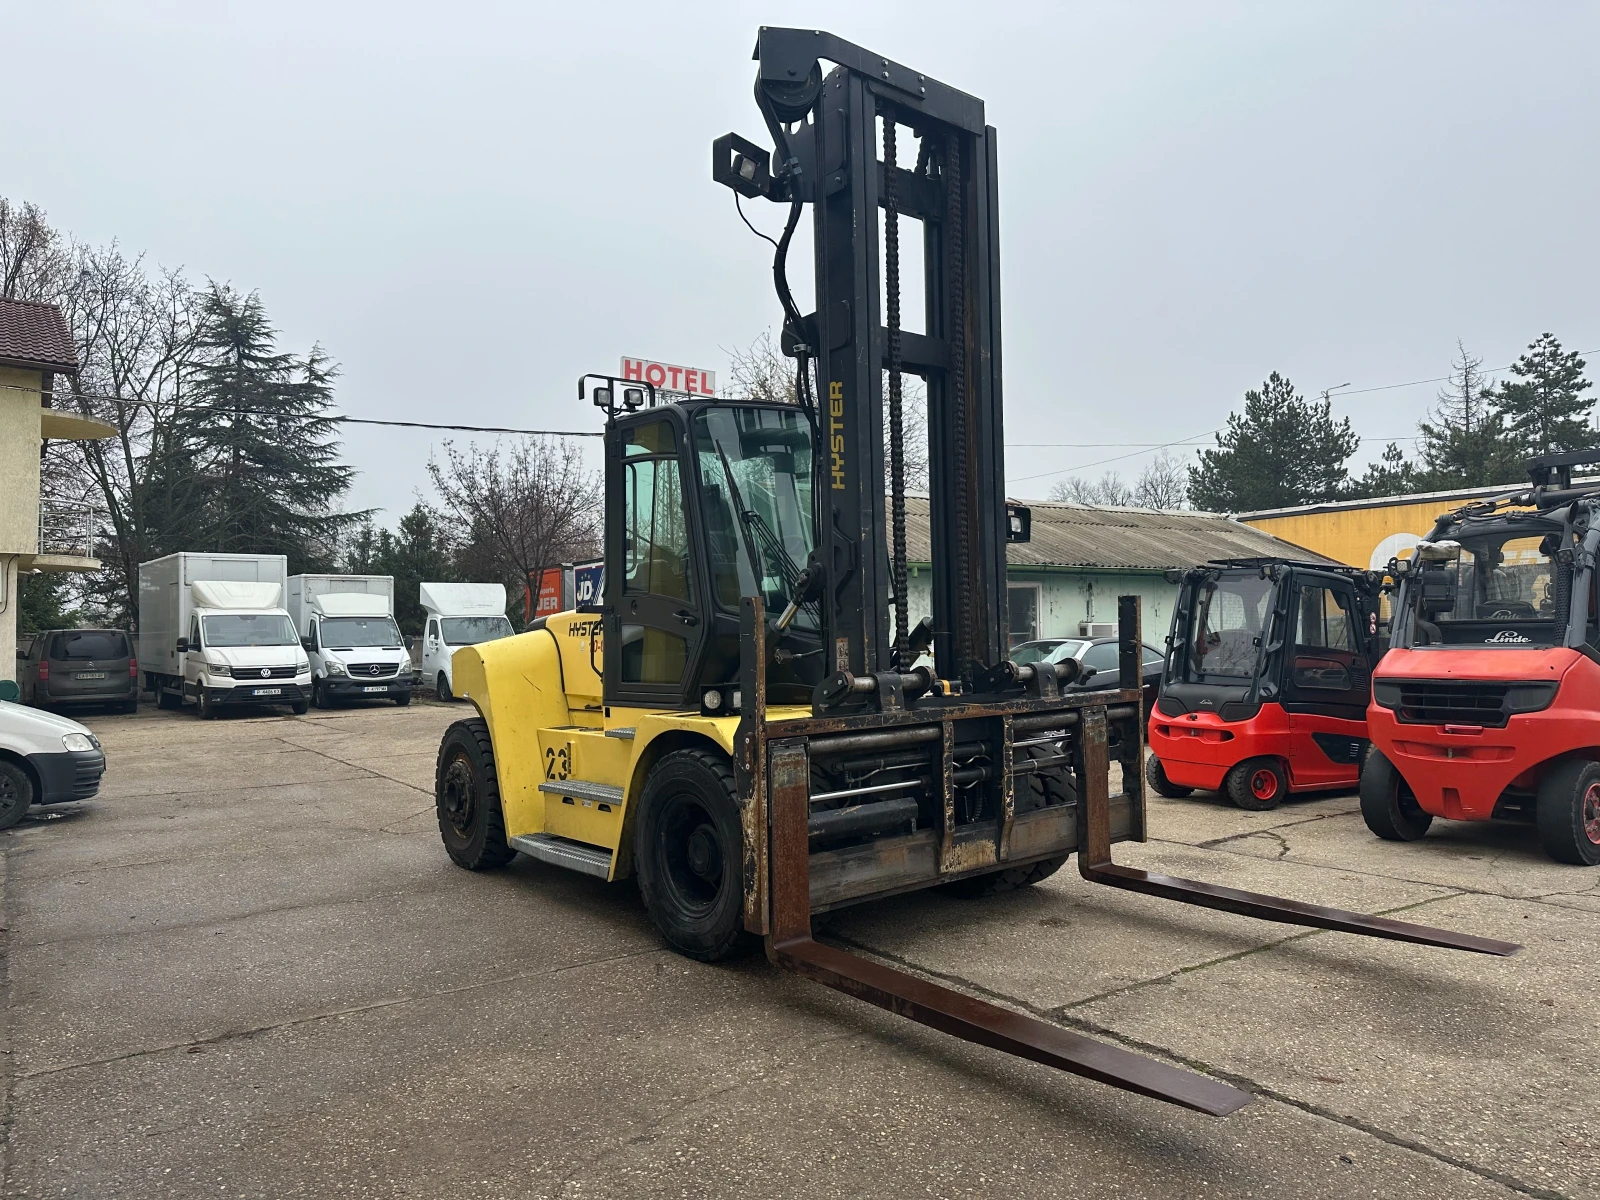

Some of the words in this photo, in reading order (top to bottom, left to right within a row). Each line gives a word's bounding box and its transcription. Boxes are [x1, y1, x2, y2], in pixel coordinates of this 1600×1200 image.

[624, 359, 713, 395] HOTEL
[829, 381, 845, 490] HYSTER
[1484, 630, 1532, 643] Linde
[546, 746, 568, 781] 23
